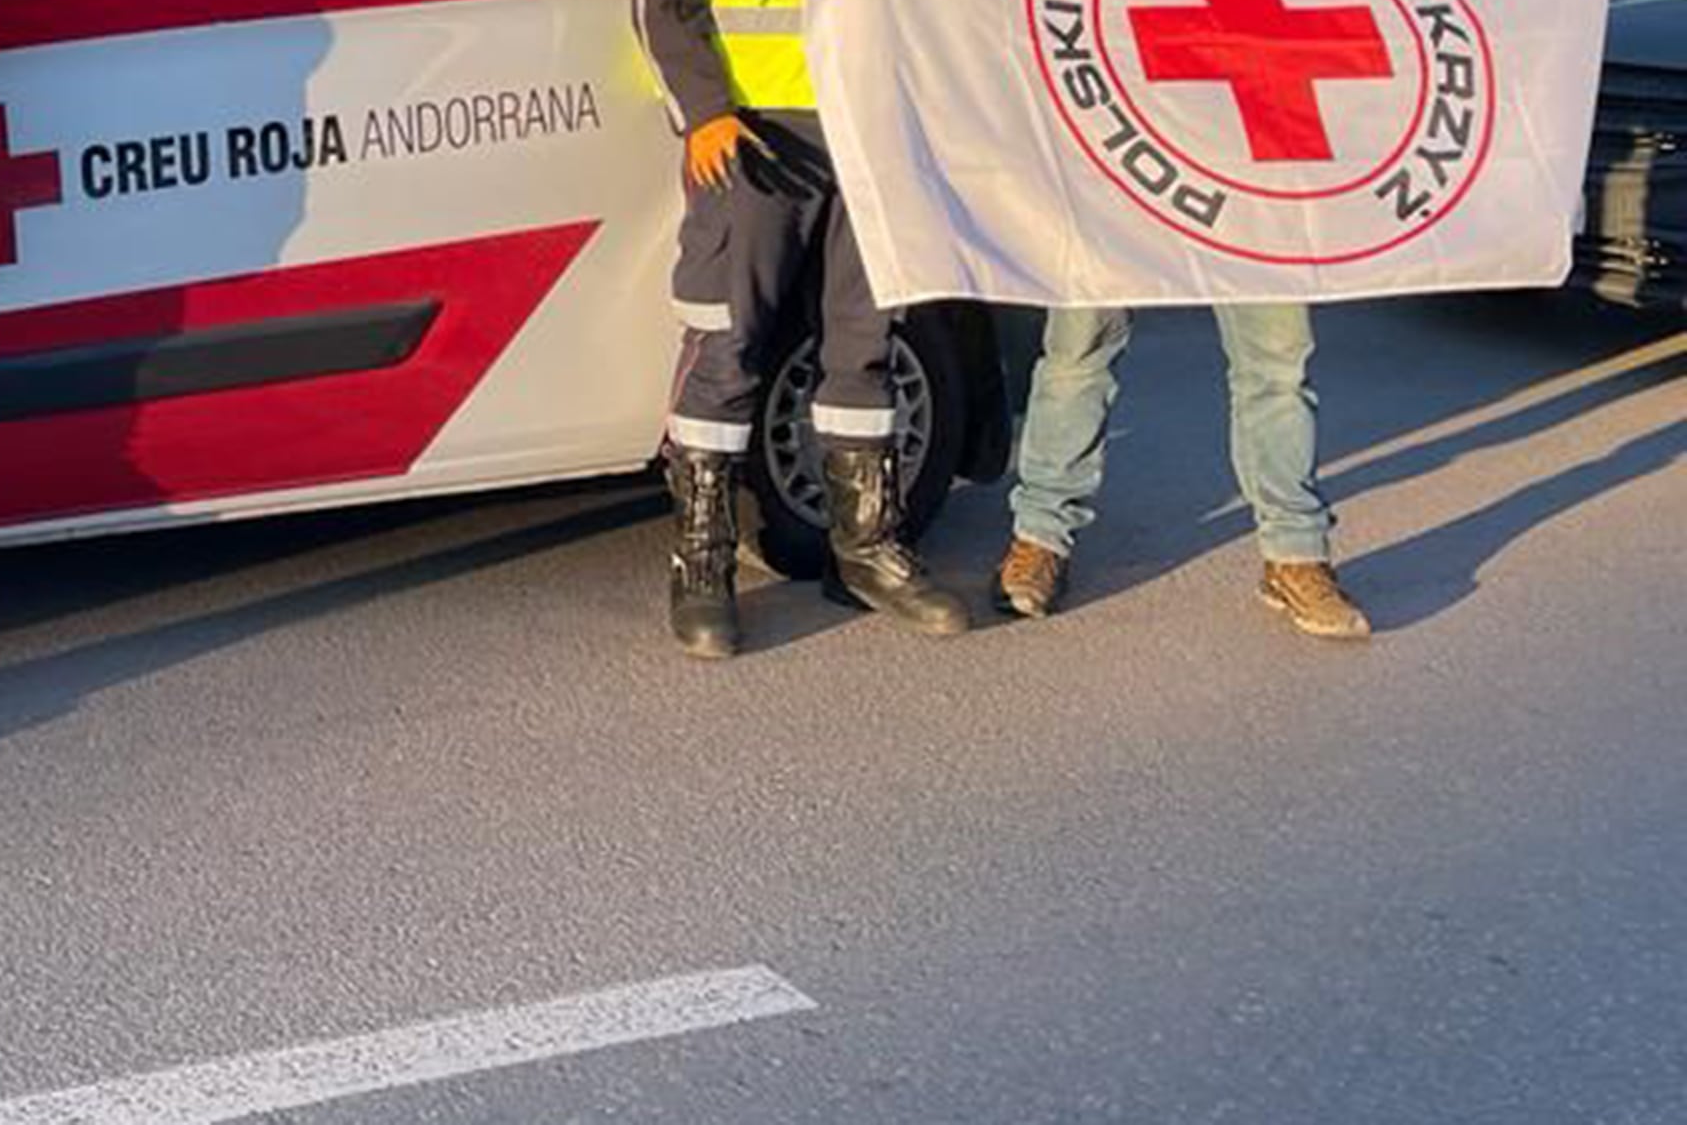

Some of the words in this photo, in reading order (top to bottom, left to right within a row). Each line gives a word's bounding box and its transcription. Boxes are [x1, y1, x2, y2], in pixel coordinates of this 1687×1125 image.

[80, 132, 210, 199] CREU
[226, 115, 347, 179] ROJA
[361, 82, 600, 159] ANDORRANA
[1044, 0, 1226, 227] POLSKI
[1375, 3, 1473, 221] KRZYŻ
